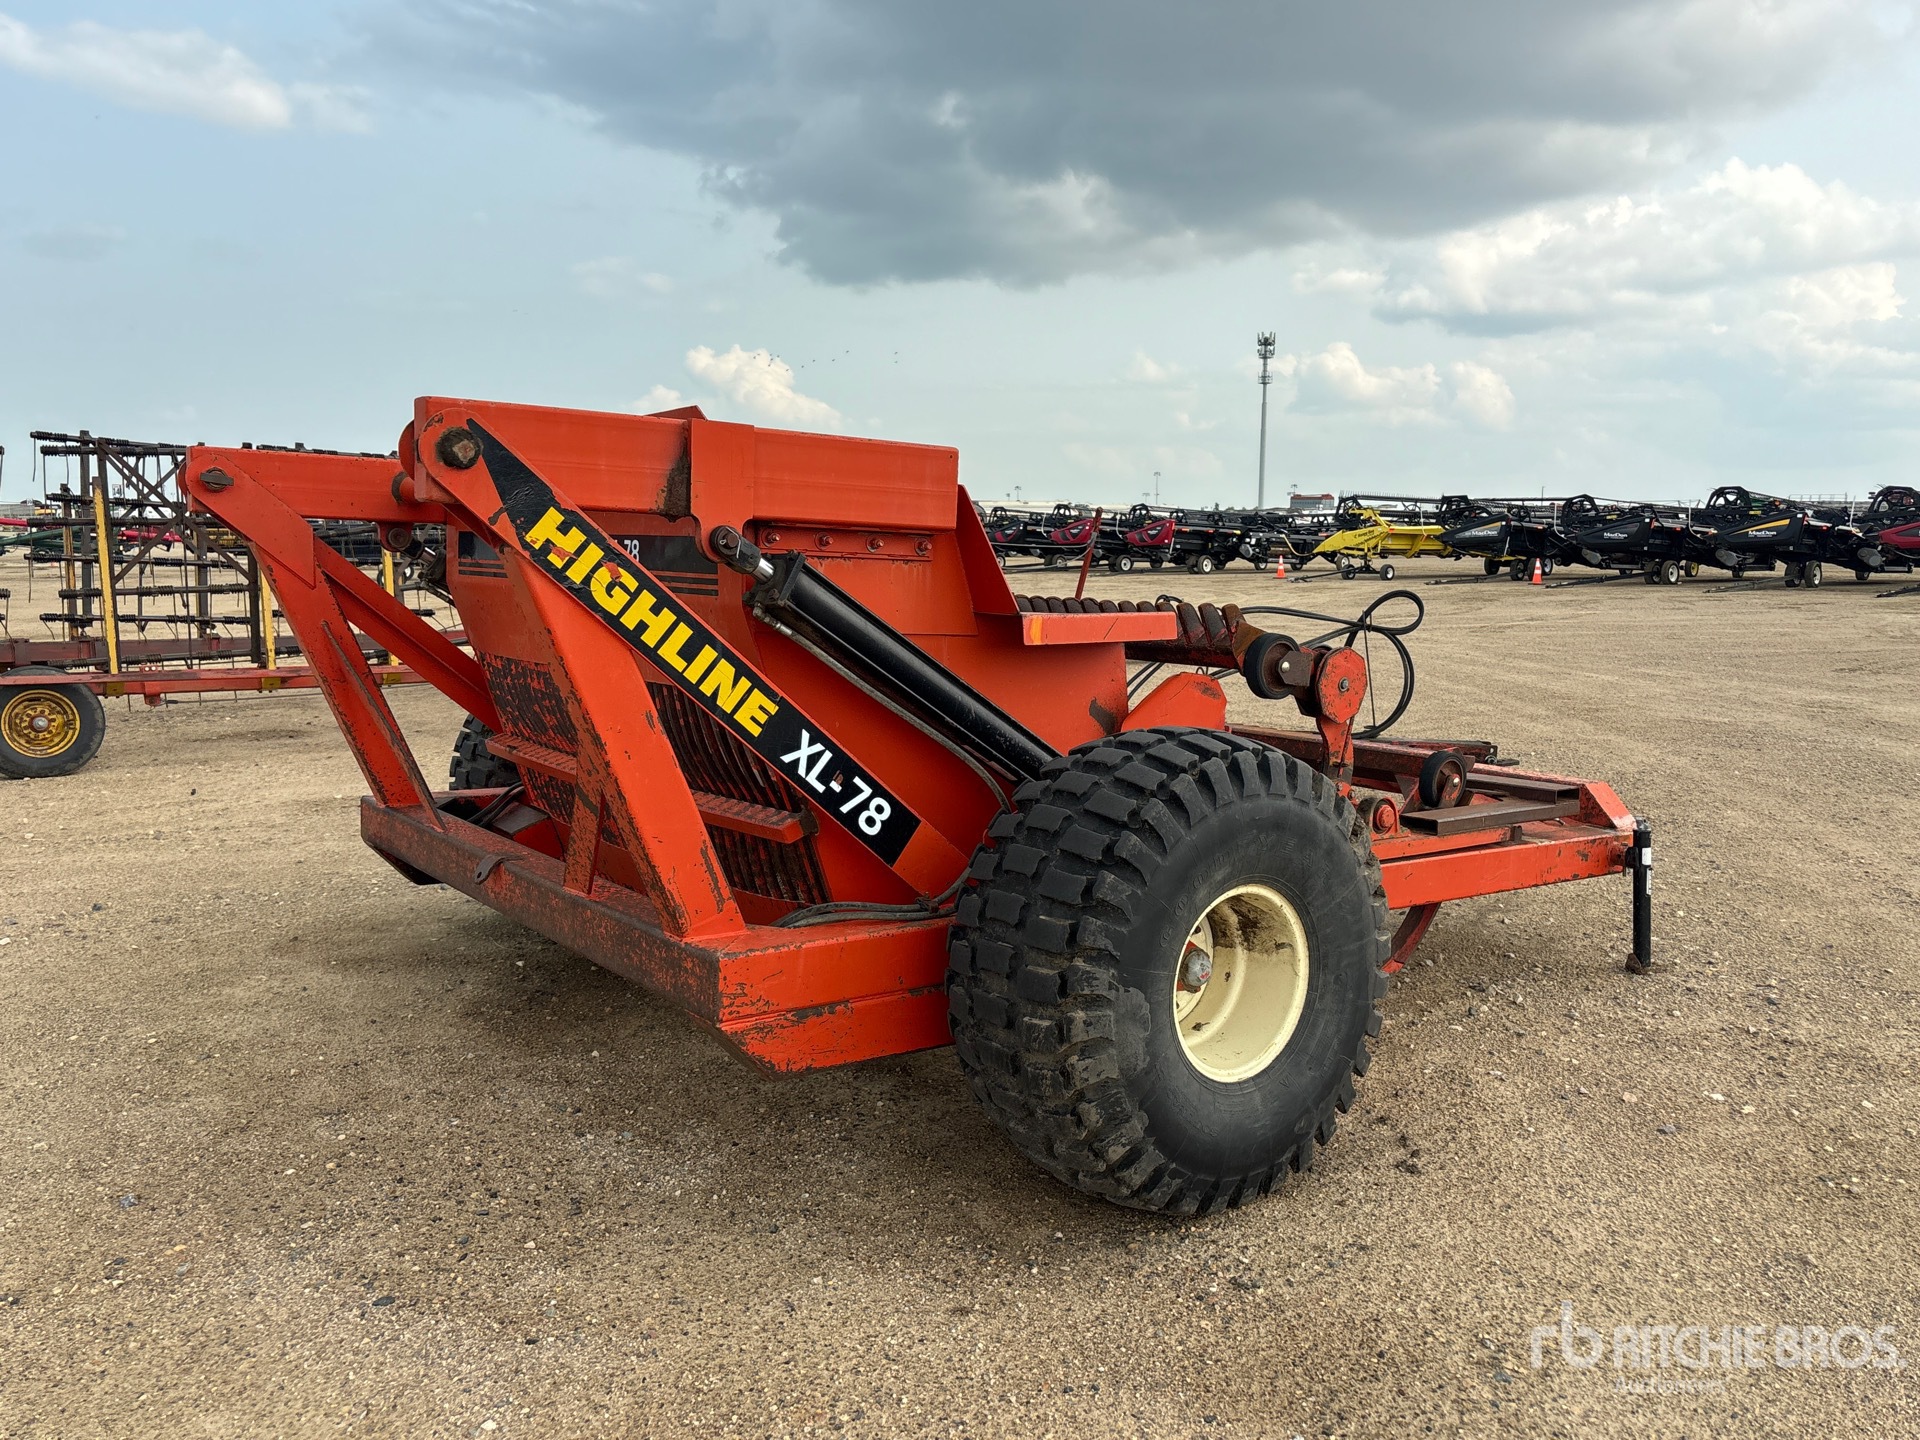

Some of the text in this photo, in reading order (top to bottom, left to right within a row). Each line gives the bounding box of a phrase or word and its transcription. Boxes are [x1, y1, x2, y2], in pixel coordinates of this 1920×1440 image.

[615, 539, 640, 562] 78
[524, 507, 891, 836] HIGHLINE XL-78
